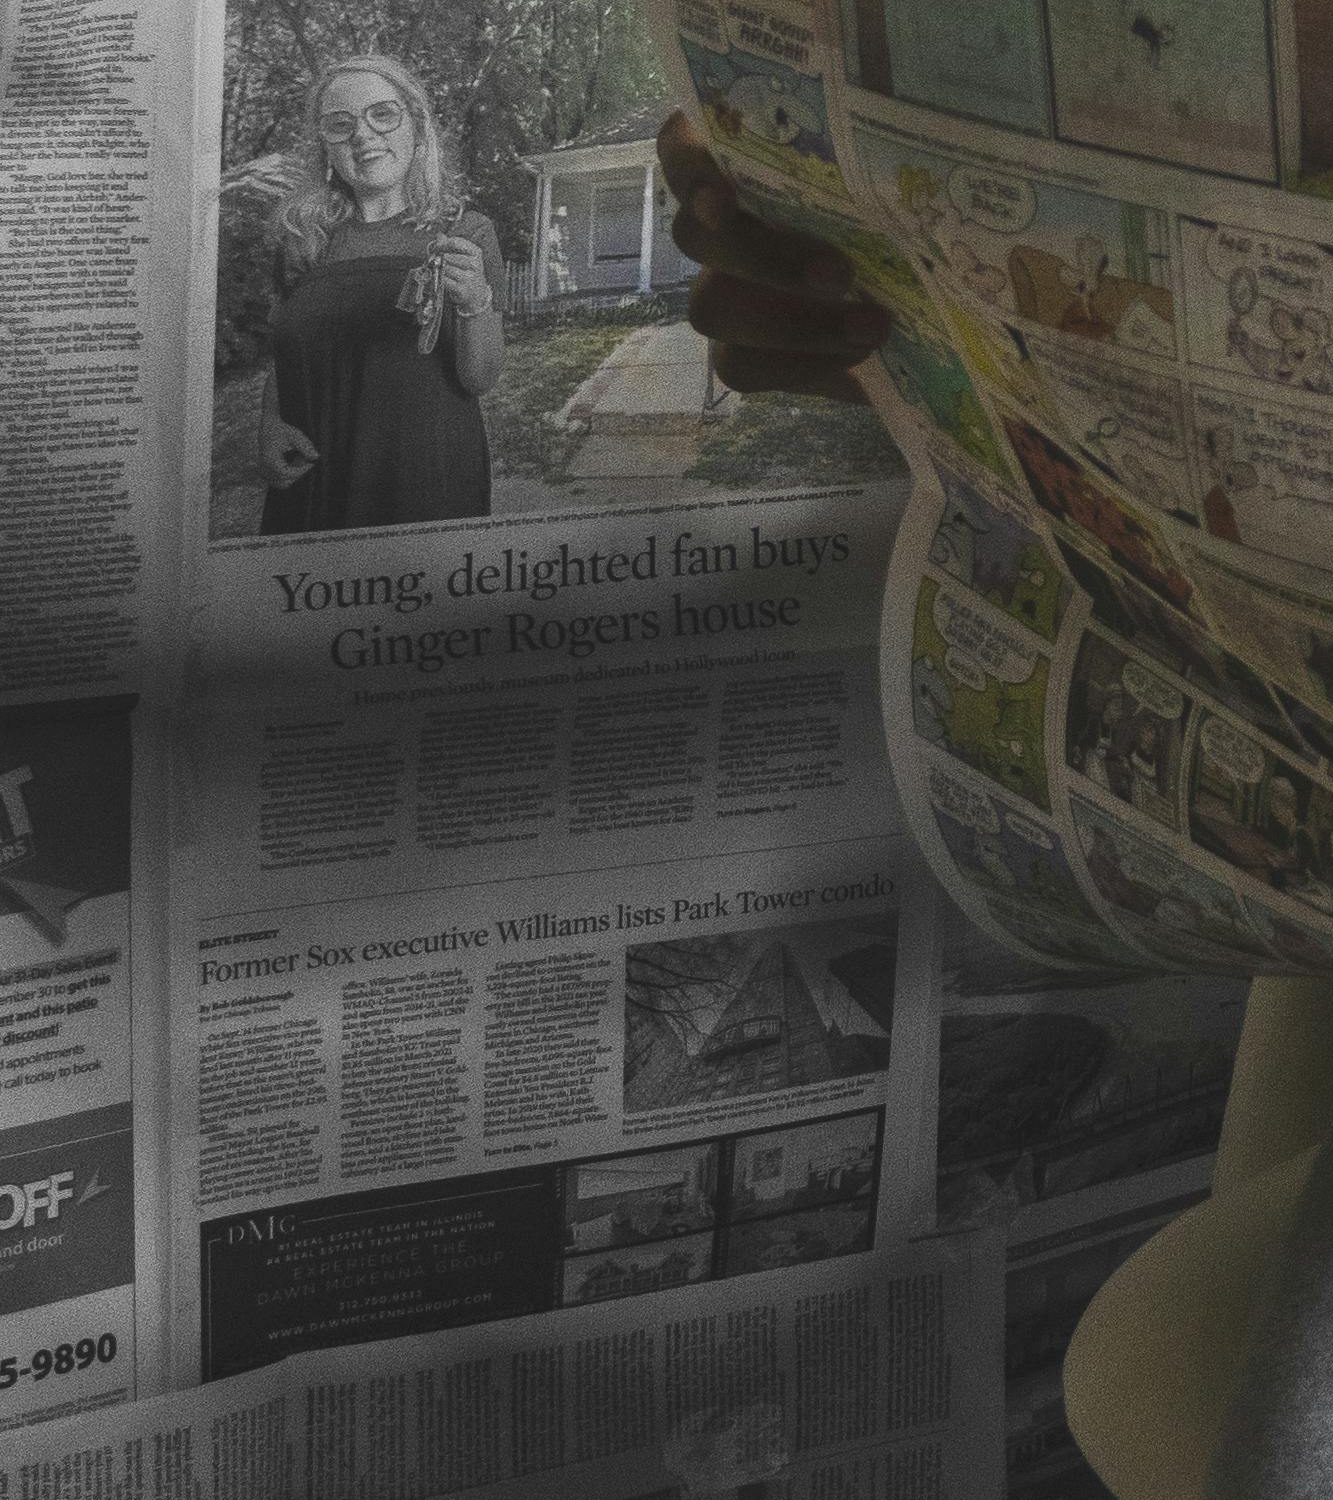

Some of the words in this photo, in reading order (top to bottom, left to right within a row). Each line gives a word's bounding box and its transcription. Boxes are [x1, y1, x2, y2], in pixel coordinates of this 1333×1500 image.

[274, 571, 433, 615] Young,
[446, 535, 657, 602] delighted
[671, 531, 740, 576] fan
[751, 527, 855, 580] buys
[329, 626, 494, 673] Ginger
[504, 611, 661, 658] Rogers
[673, 594, 801, 637] house
